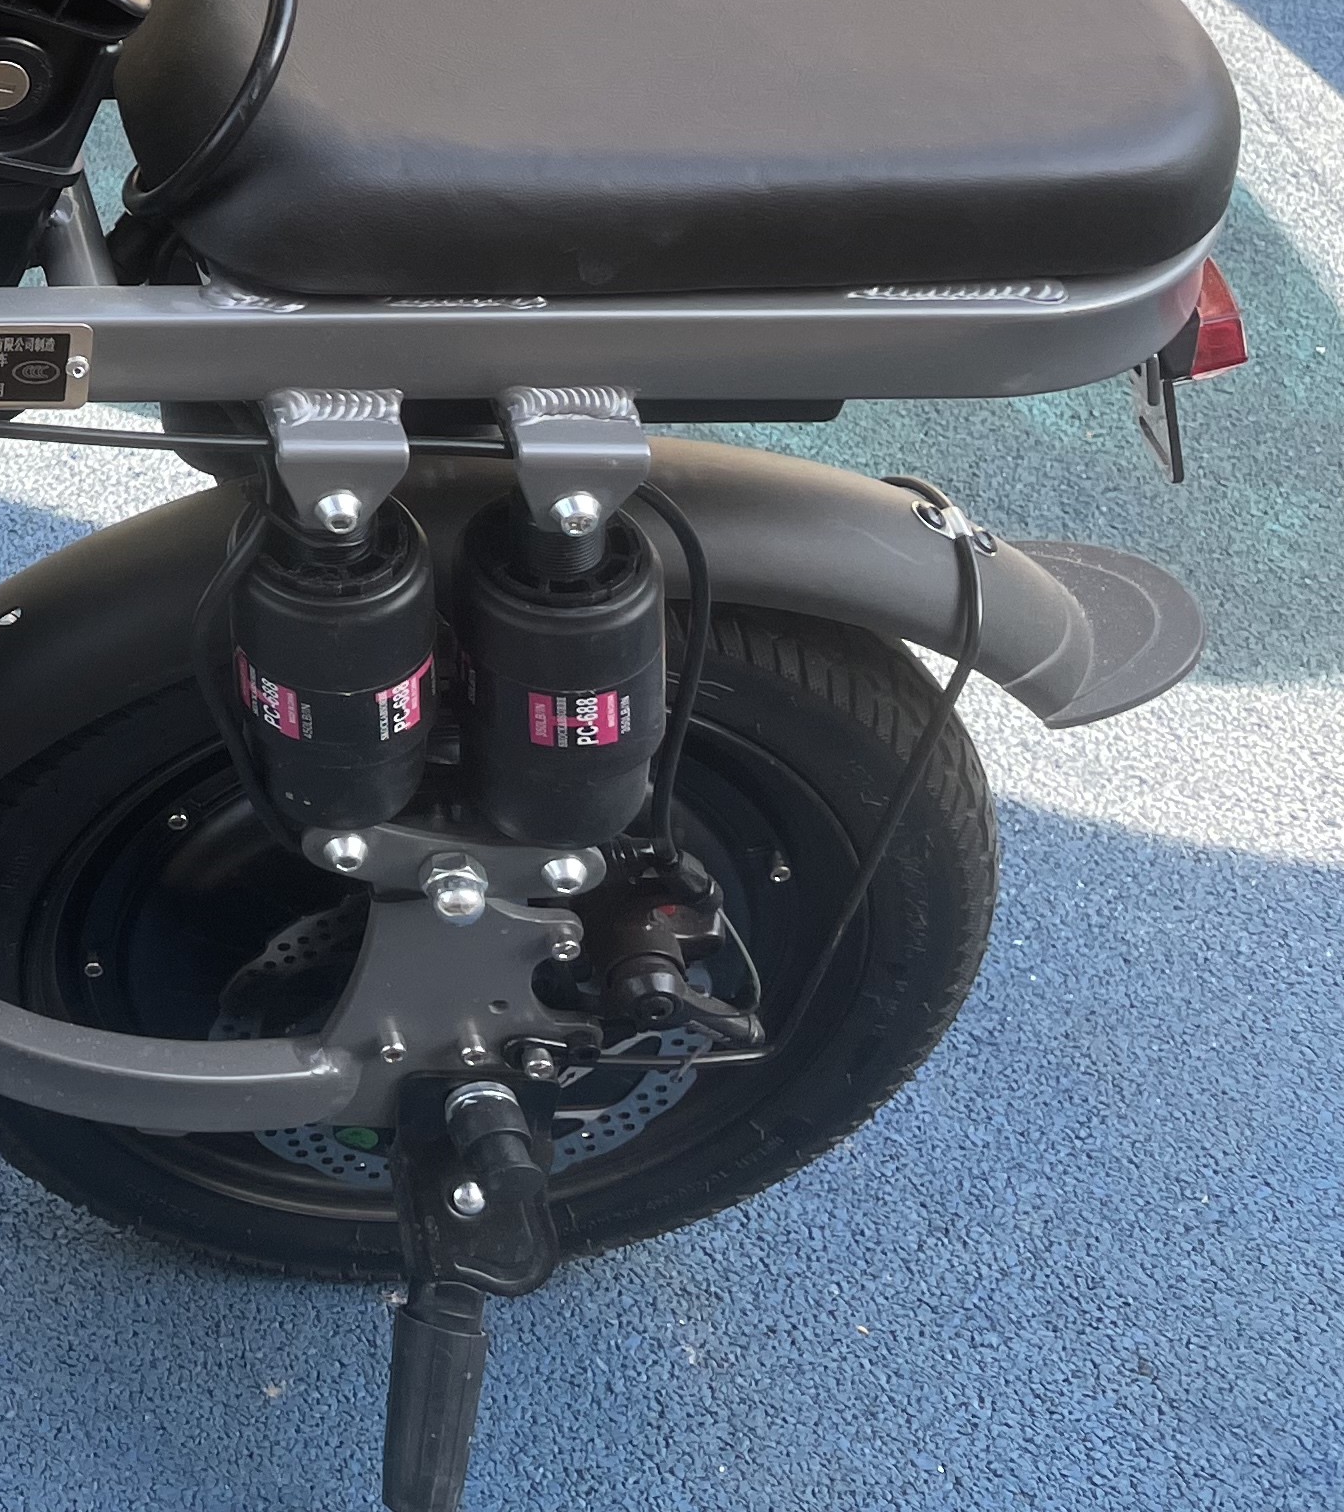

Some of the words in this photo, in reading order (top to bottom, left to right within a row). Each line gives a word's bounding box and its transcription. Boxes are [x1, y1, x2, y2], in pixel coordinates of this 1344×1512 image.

[263, 677, 280, 729] PC-688
[392, 680, 412, 734] PC-688
[576, 696, 600, 747] PC-688
